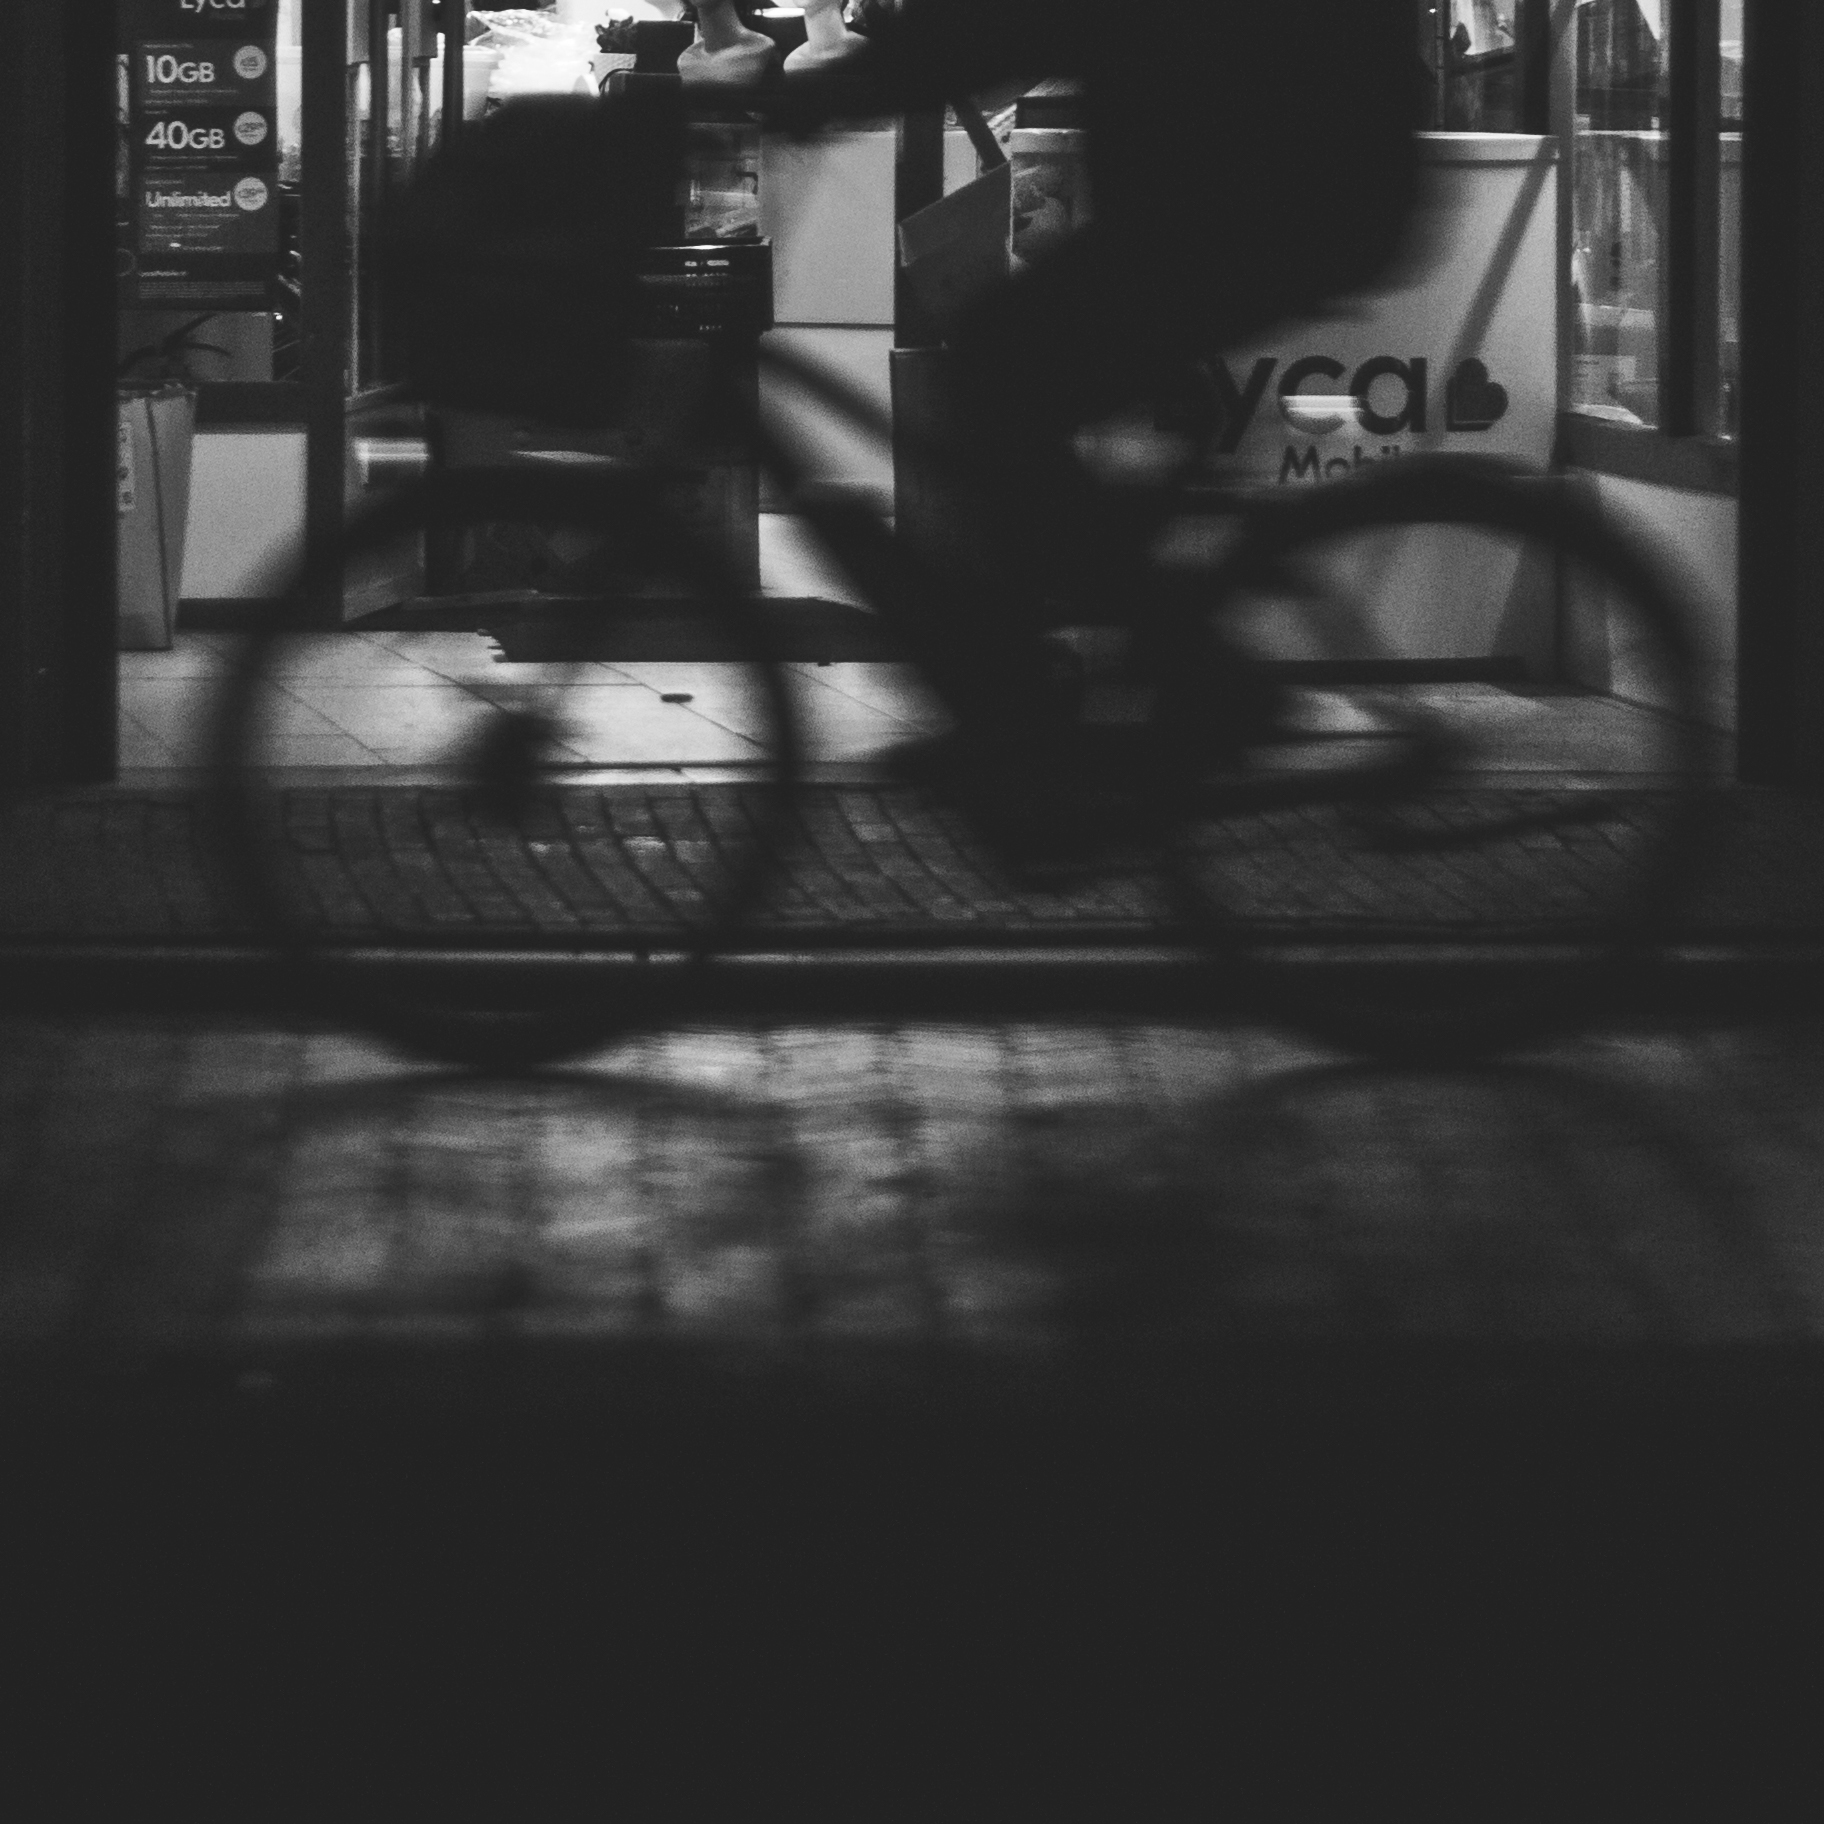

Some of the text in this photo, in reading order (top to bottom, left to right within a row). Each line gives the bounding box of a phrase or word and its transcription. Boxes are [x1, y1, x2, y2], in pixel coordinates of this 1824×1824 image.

[145, 54, 216, 84] 10GB
[145, 121, 226, 150] 40GB
[145, 190, 232, 208] Unlimited
[1158, 354, 1427, 456] yca
